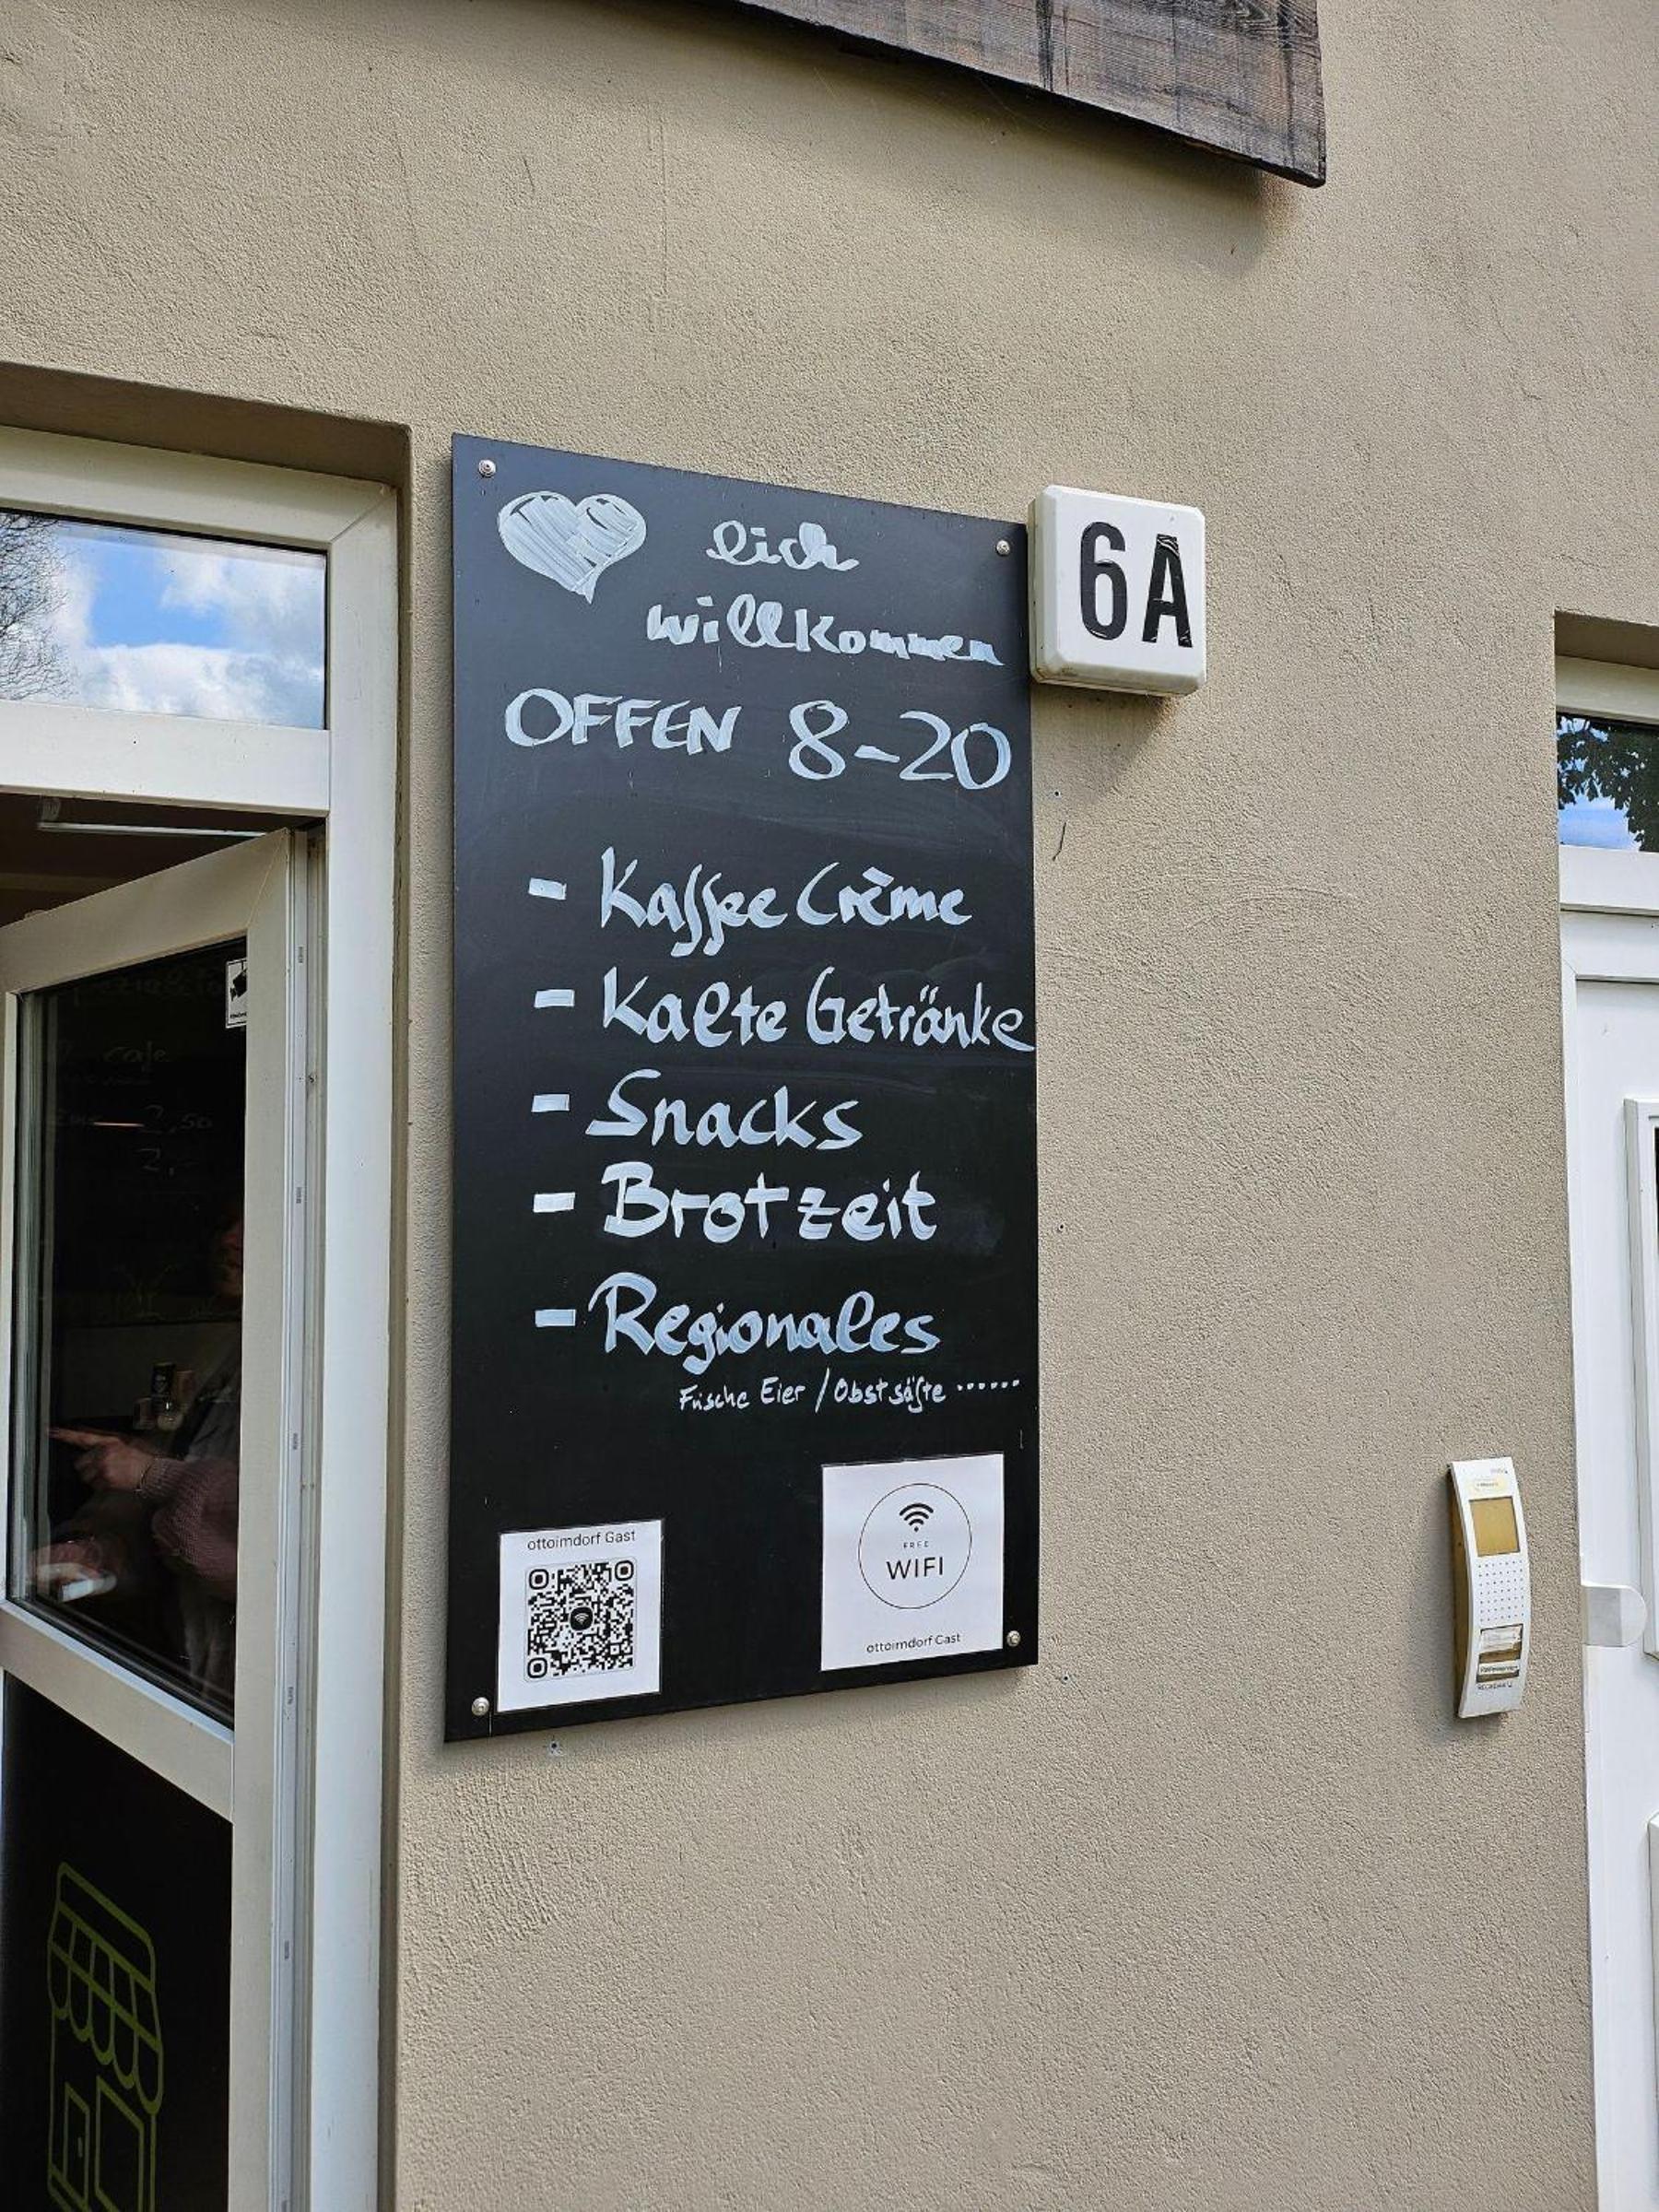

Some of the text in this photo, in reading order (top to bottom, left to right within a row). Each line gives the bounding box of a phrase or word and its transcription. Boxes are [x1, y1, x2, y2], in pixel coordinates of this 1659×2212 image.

[1080, 521, 1193, 648] 6A
[505, 688, 742, 756] OFFEN
[600, 846, 787, 958] Kaffee
[795, 862, 972, 926] Crème
[603, 966, 787, 1048] Kalte
[806, 966, 1036, 1052] Getränke
[584, 1068, 863, 1150] Snacks
[588, 1272, 941, 1374] Regionales
[760, 1376, 806, 1405] Eier
[527, 1530, 636, 1550] ottoimdorf Gast
[886, 1556, 944, 1581] WIFI
[866, 1634, 933, 1653] ottoimdorf
